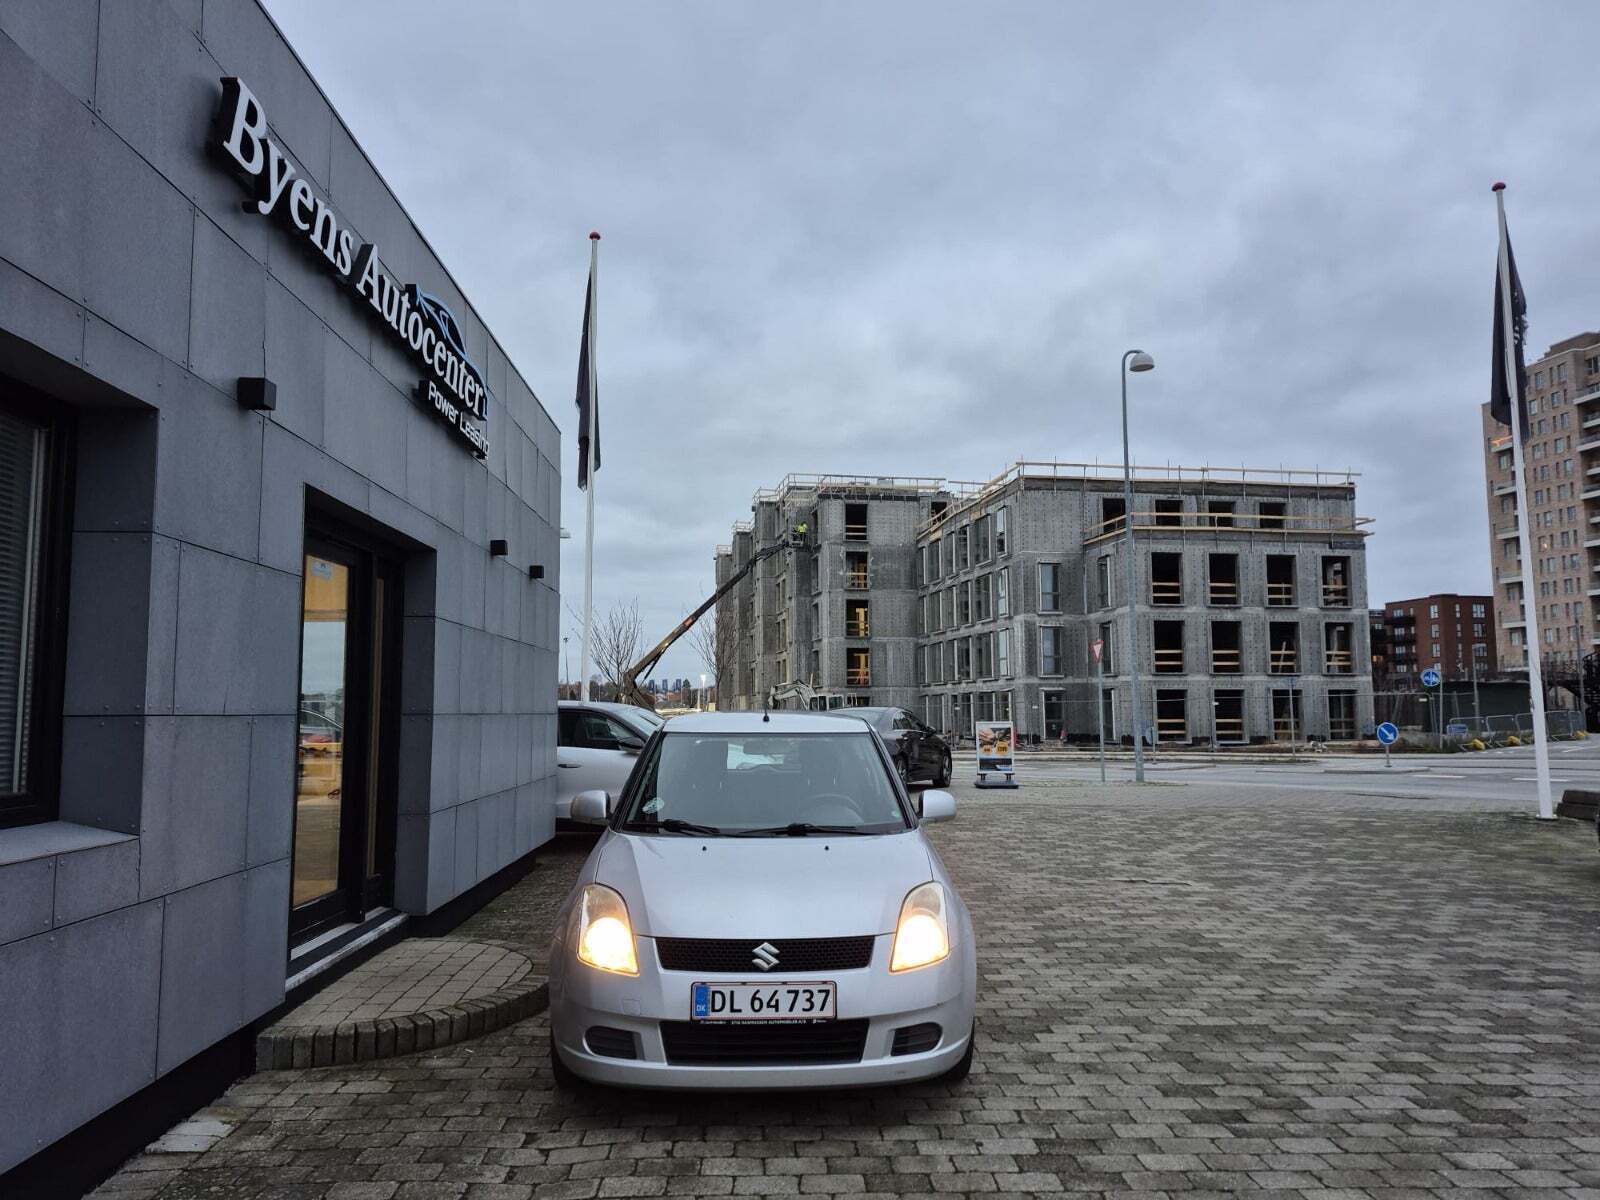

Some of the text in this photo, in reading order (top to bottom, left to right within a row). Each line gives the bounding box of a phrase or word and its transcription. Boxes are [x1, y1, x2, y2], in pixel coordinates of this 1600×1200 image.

[222, 77, 485, 416] Byens Autocenter
[428, 380, 459, 425] Power
[696, 1004, 706, 1012] DK
[711, 989, 831, 1013] DL 64 737
